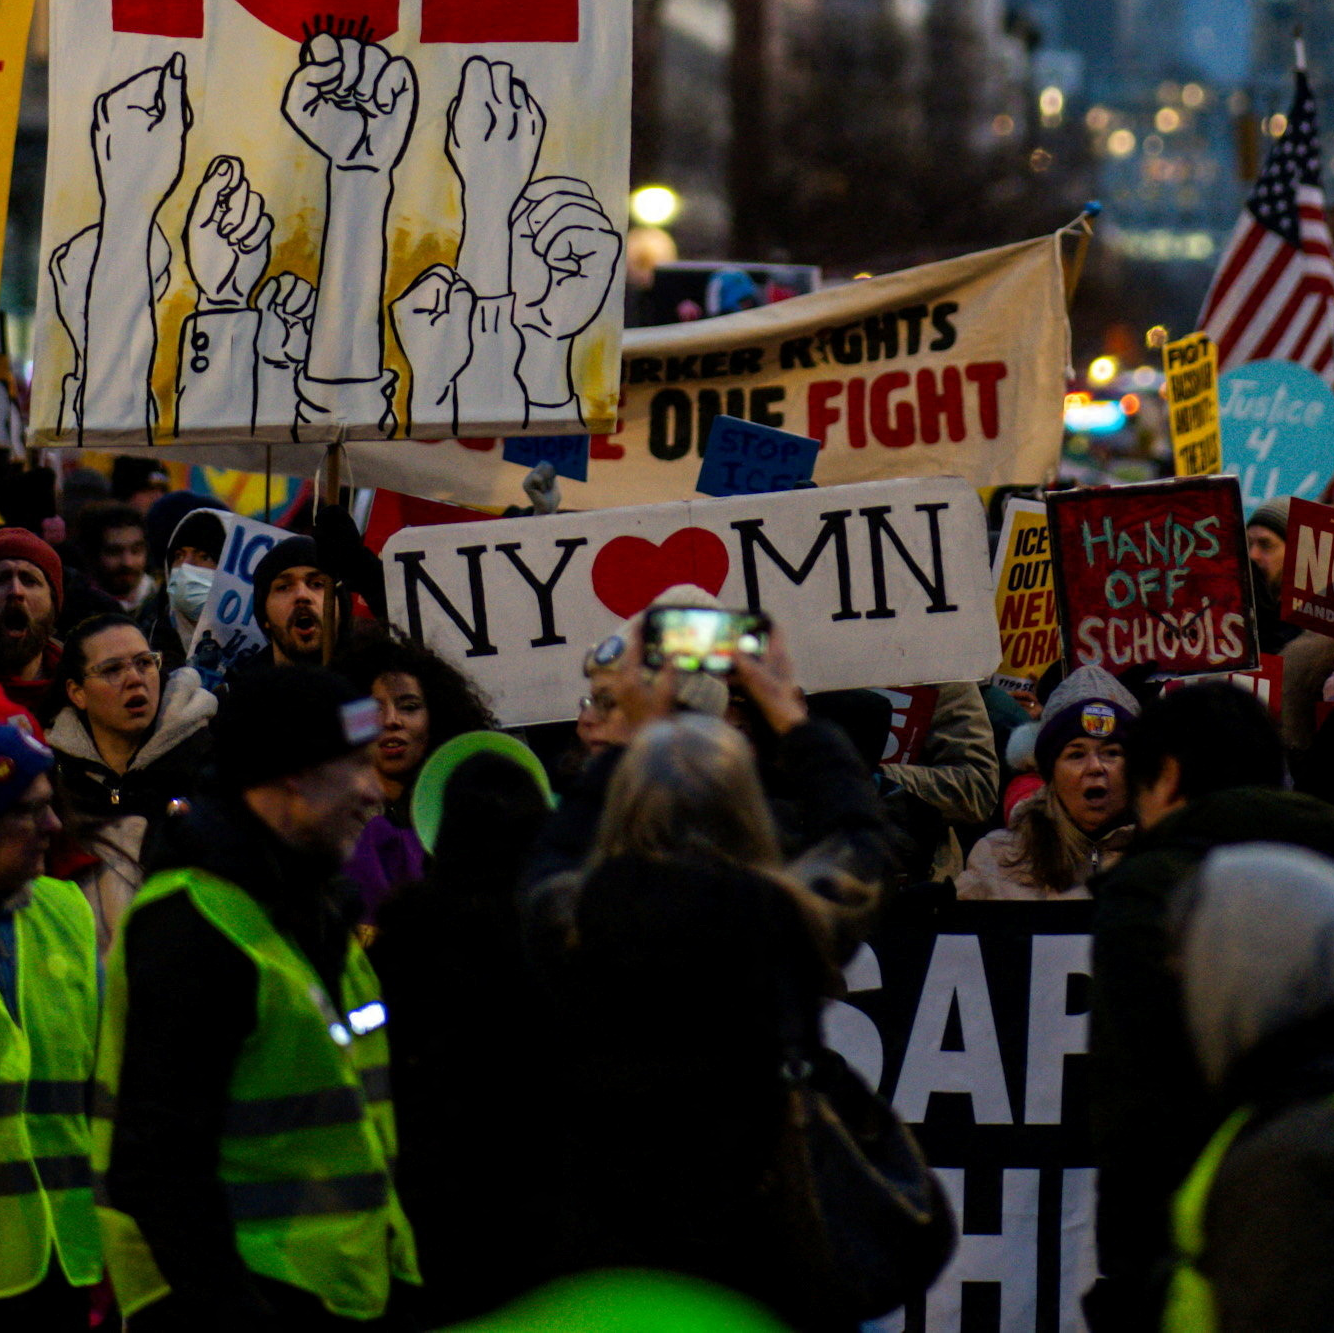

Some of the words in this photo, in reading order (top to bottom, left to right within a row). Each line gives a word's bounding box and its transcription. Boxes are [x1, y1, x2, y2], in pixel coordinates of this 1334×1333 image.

[807, 361, 1007, 450] FIGHT
[720, 429, 801, 463] STOP
[1245, 426, 1279, 462] 4
[731, 502, 959, 620] MN
[1014, 526, 1050, 557] ICE
[1081, 512, 1221, 566] HANDS
[394, 537, 587, 657] NY
[1008, 560, 1053, 592] OUT
[1104, 566, 1191, 609] OFF
[1076, 596, 1245, 664] SCHOOLS
